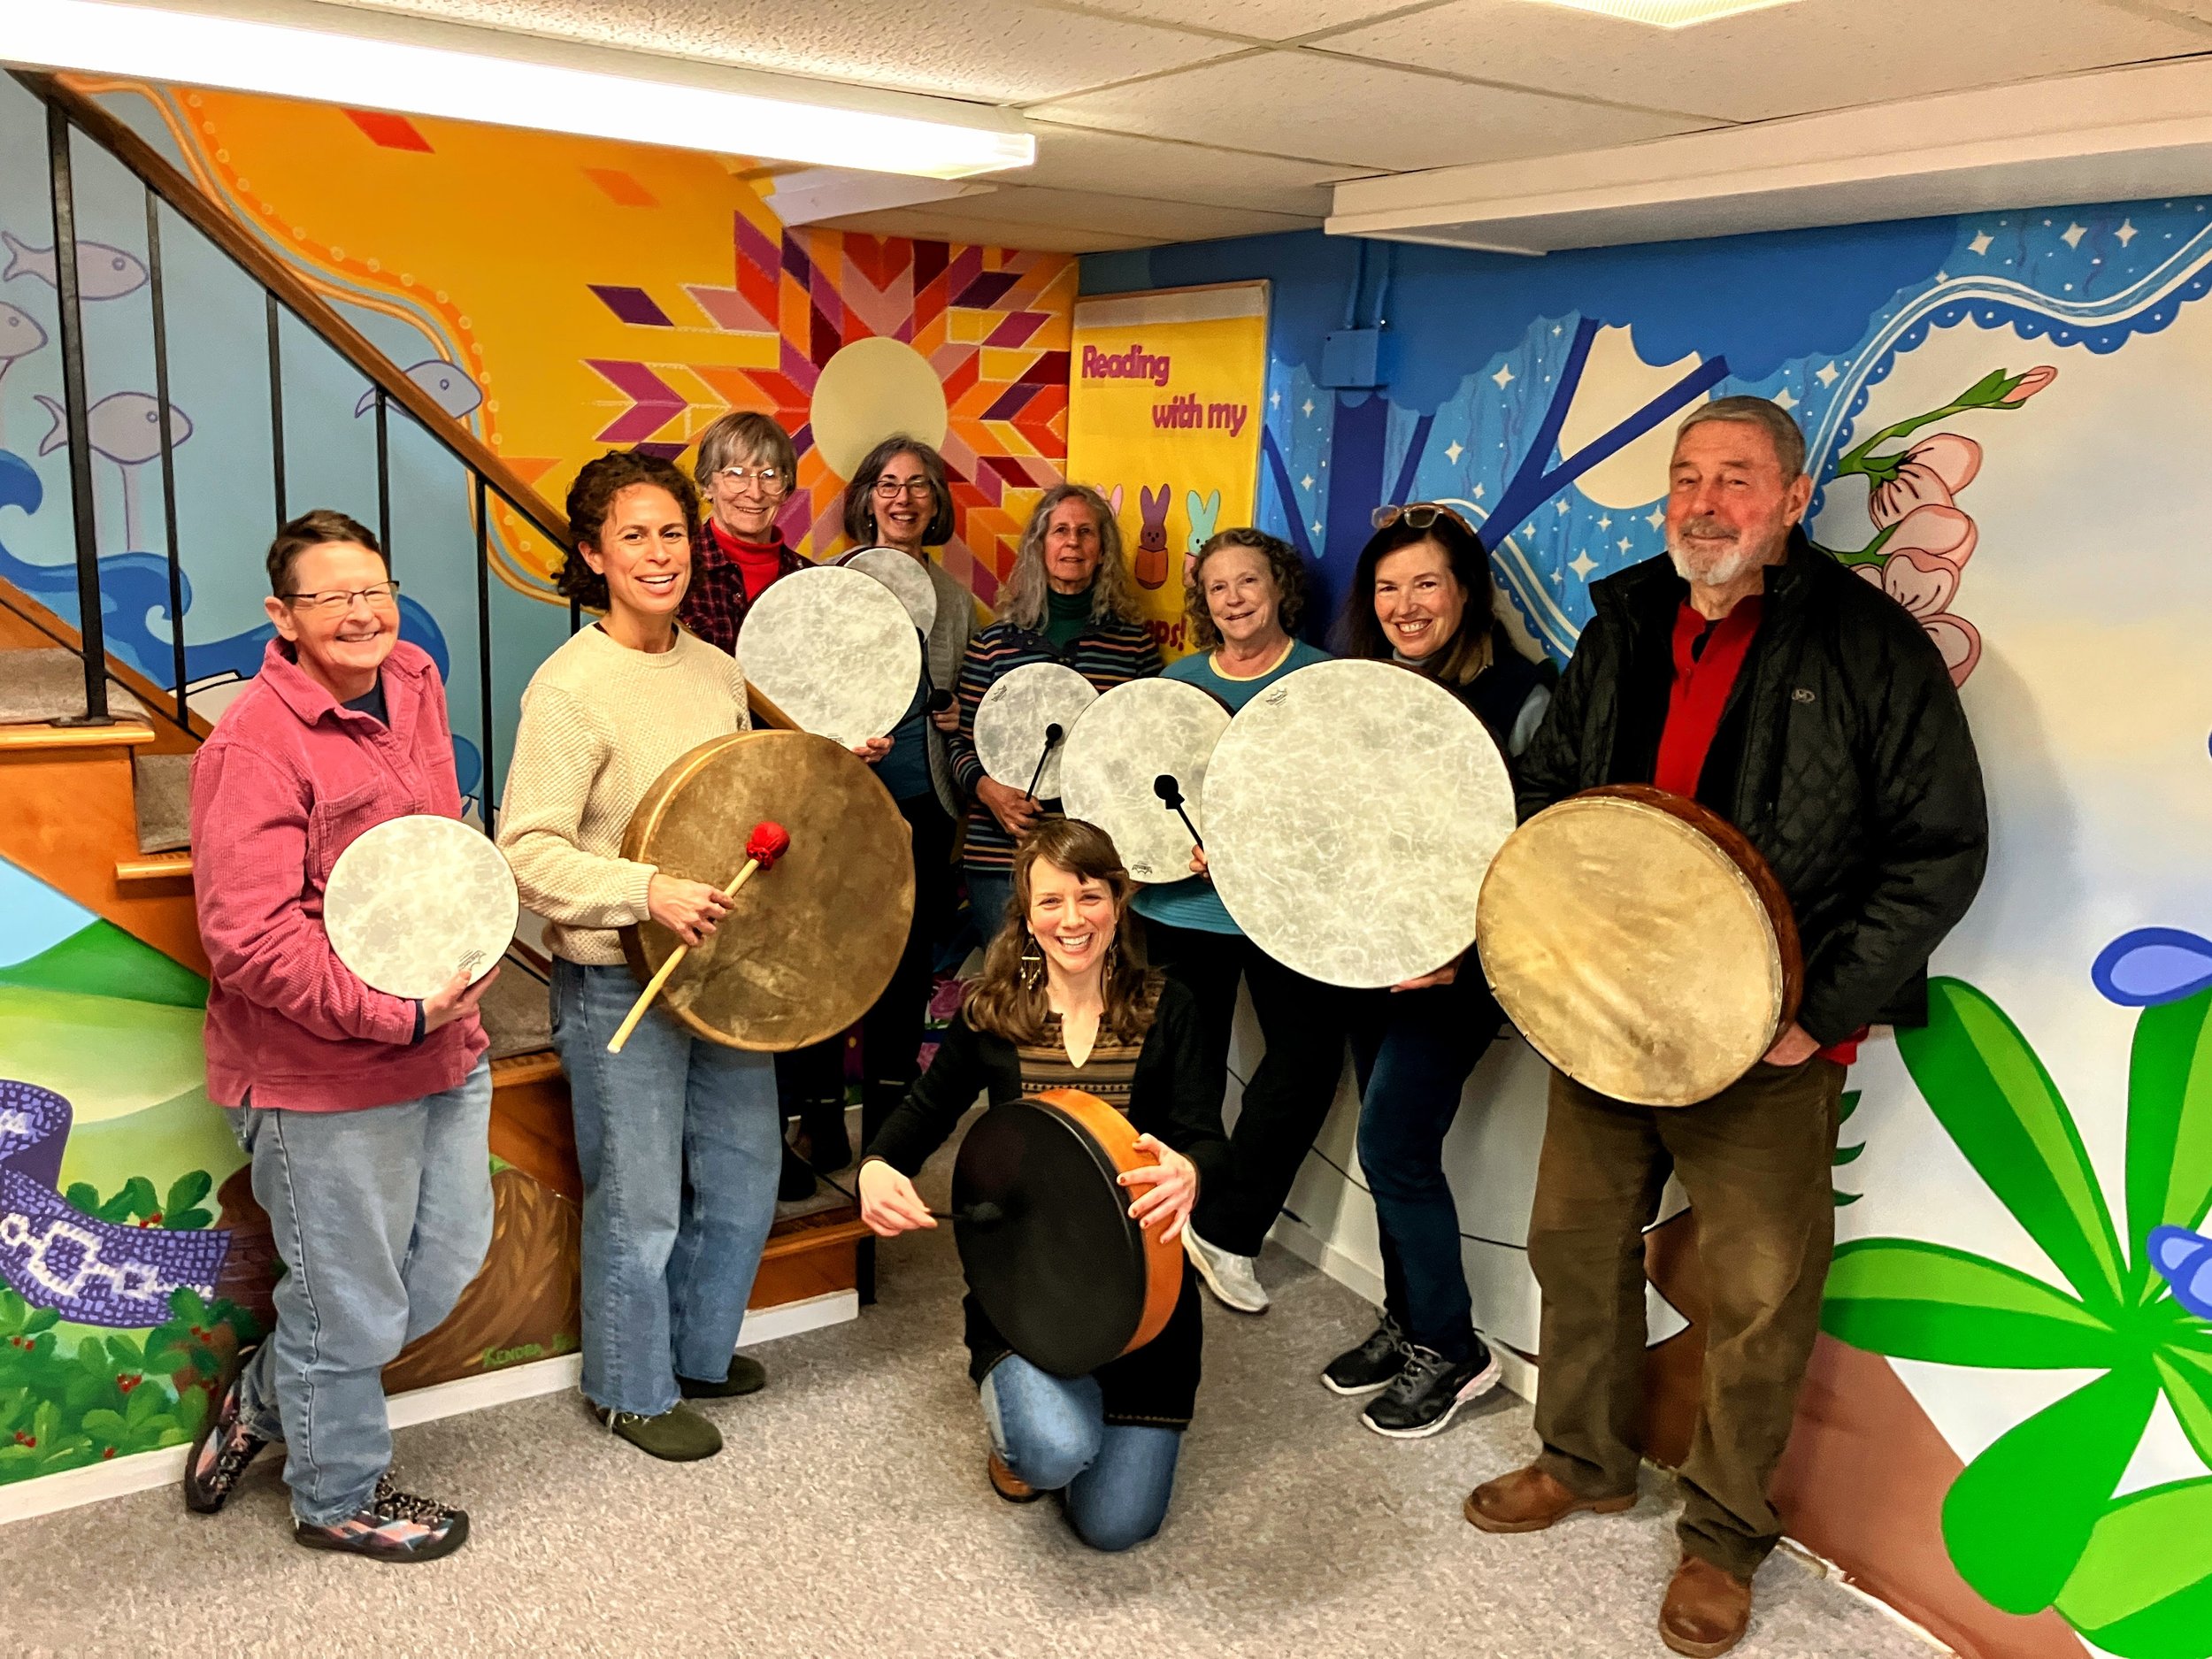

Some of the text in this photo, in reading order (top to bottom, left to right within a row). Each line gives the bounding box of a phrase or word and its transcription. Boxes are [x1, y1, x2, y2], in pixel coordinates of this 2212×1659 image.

[1082, 344, 1171, 387] Reading
[1153, 392, 1248, 438] with my
